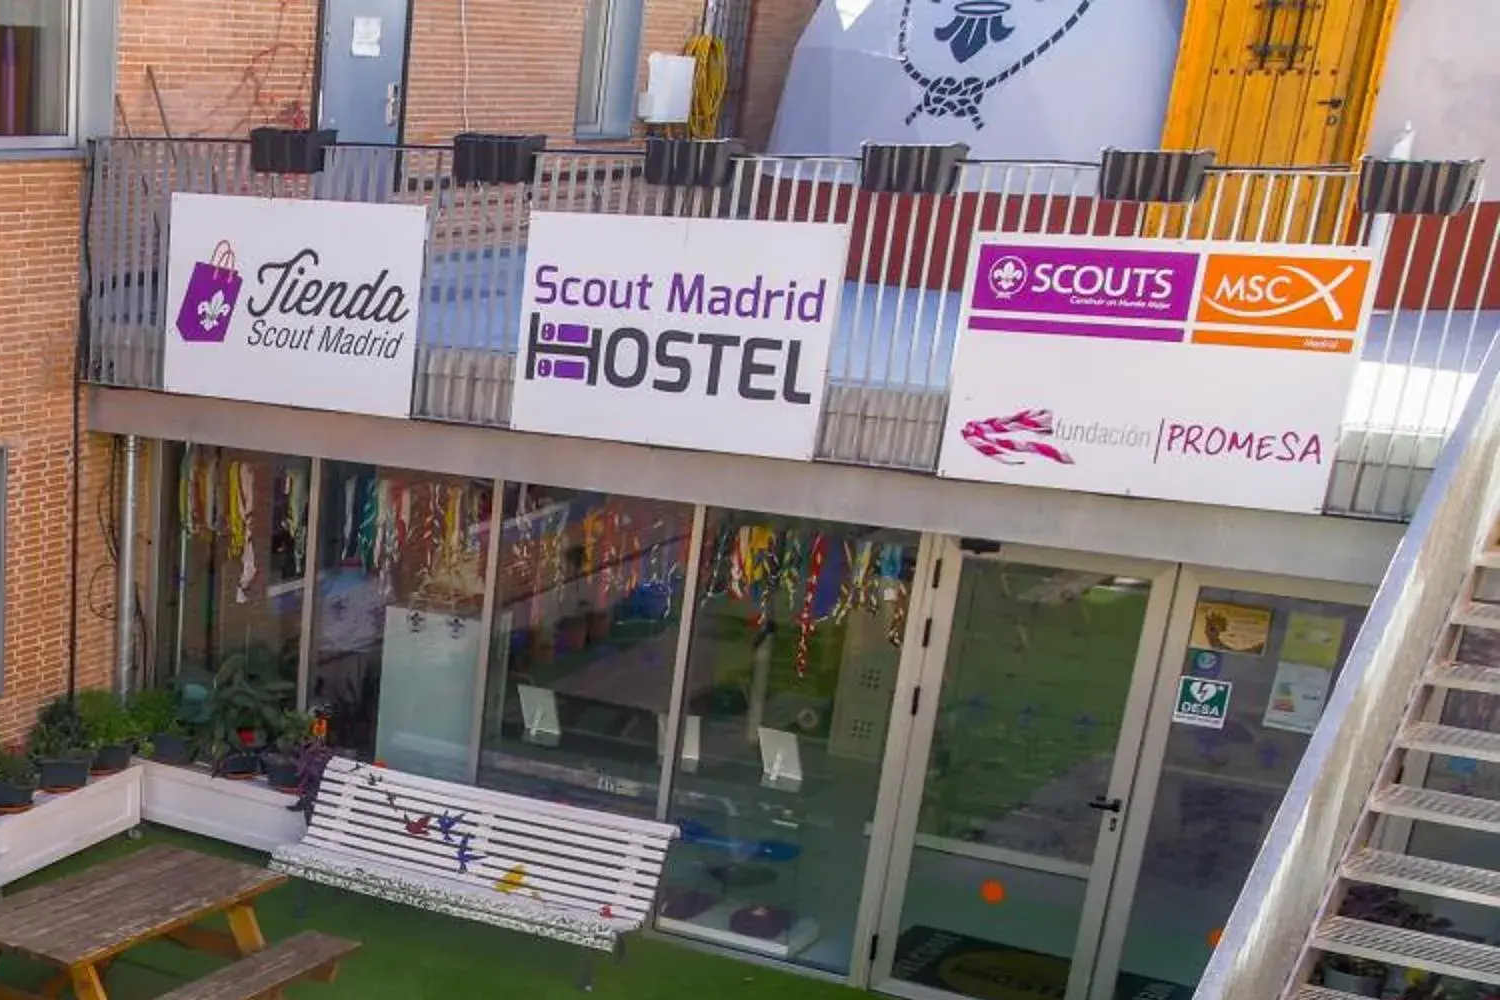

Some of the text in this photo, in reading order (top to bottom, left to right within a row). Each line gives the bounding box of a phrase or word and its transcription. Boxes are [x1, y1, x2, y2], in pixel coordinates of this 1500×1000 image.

[248, 248, 409, 323] Tienda
[534, 265, 827, 323] Scout Madrid
[1031, 262, 1174, 299] SCOUTS
[1215, 273, 1292, 304] MSC
[247, 319, 405, 359] Scout Madrid
[525, 311, 812, 404] HOSTEL
[1053, 418, 1322, 464] fundación PROMESA
[1181, 701, 1219, 717] DESA
